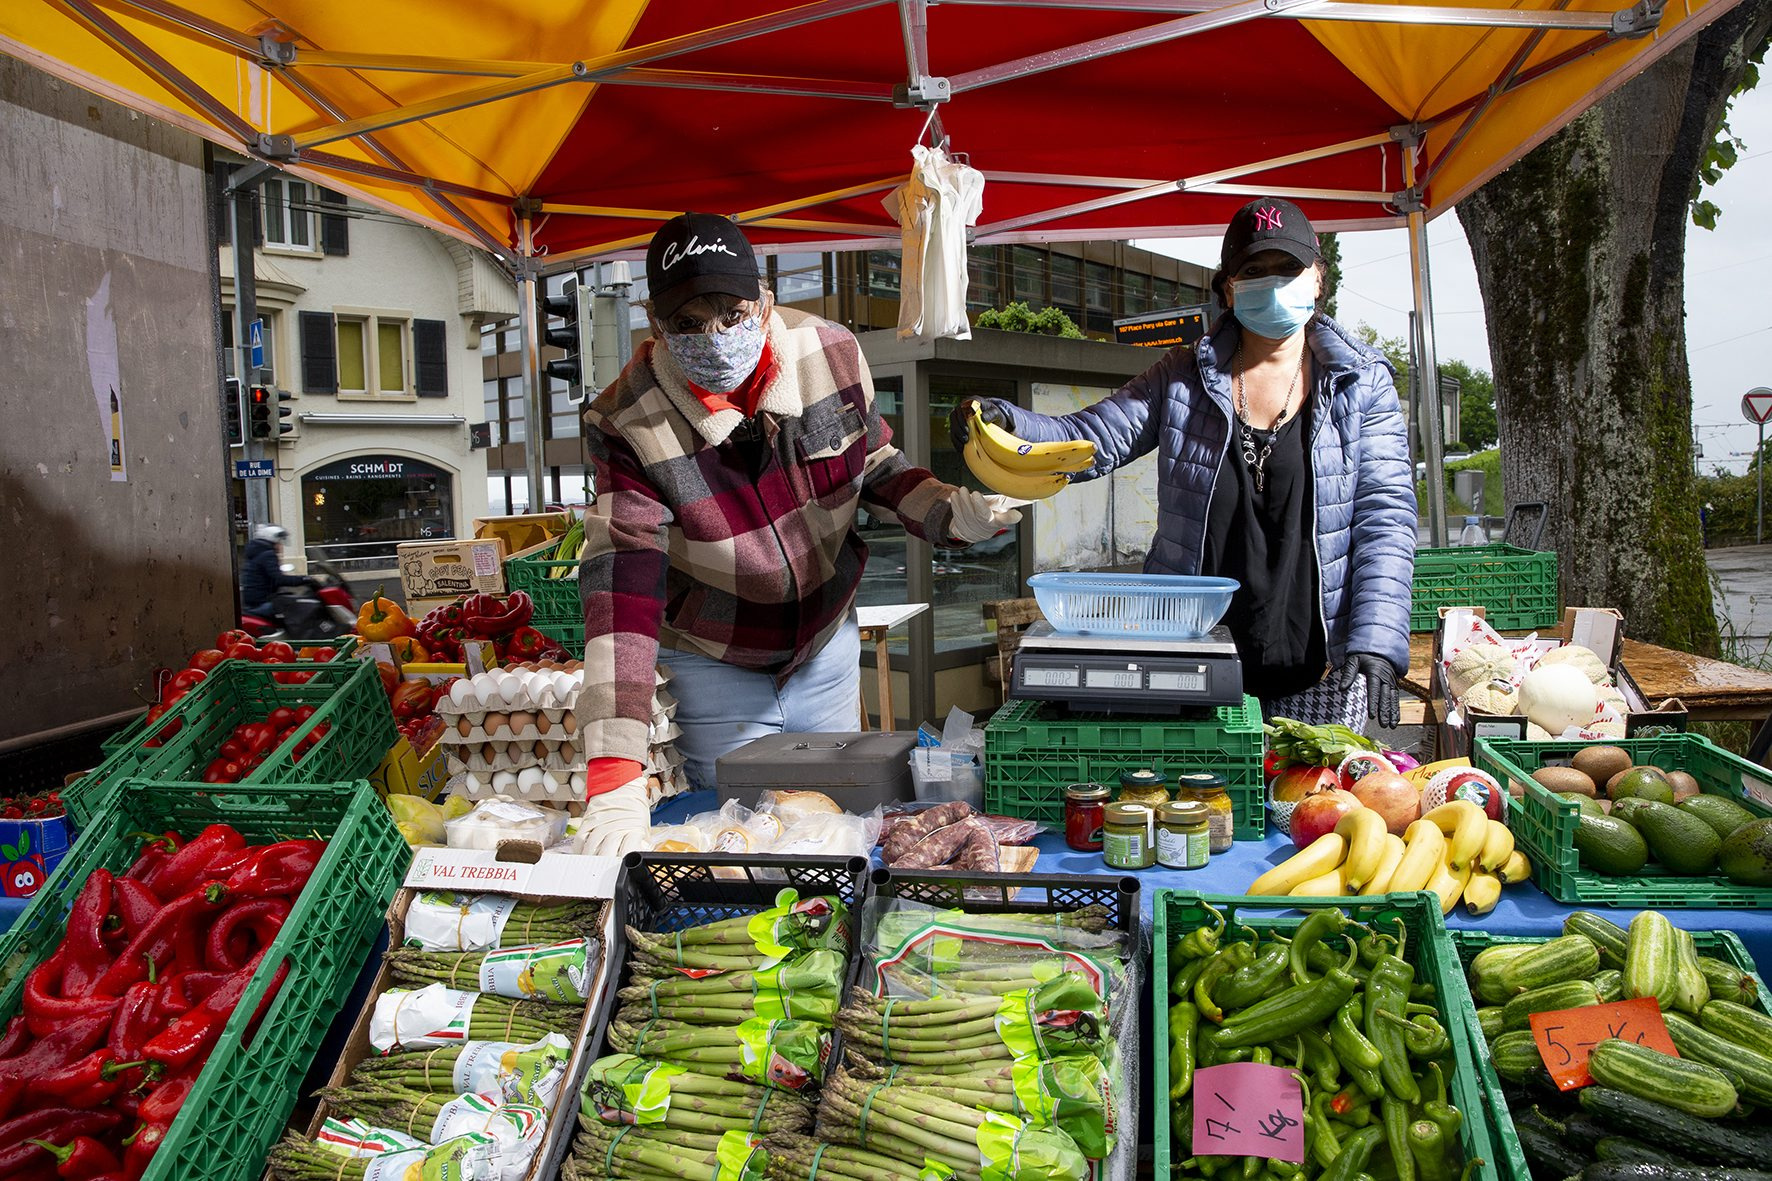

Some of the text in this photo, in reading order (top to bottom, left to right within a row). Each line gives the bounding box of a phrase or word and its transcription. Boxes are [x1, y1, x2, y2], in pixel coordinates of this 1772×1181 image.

[662, 235, 737, 271] Calvin
[1143, 322, 1155, 330] Pury
[249, 461, 261, 469] RUE
[239, 469, 247, 477] DE
[437, 581, 469, 589] SALENTINA
[433, 865, 518, 881] VAL TREBBIA
